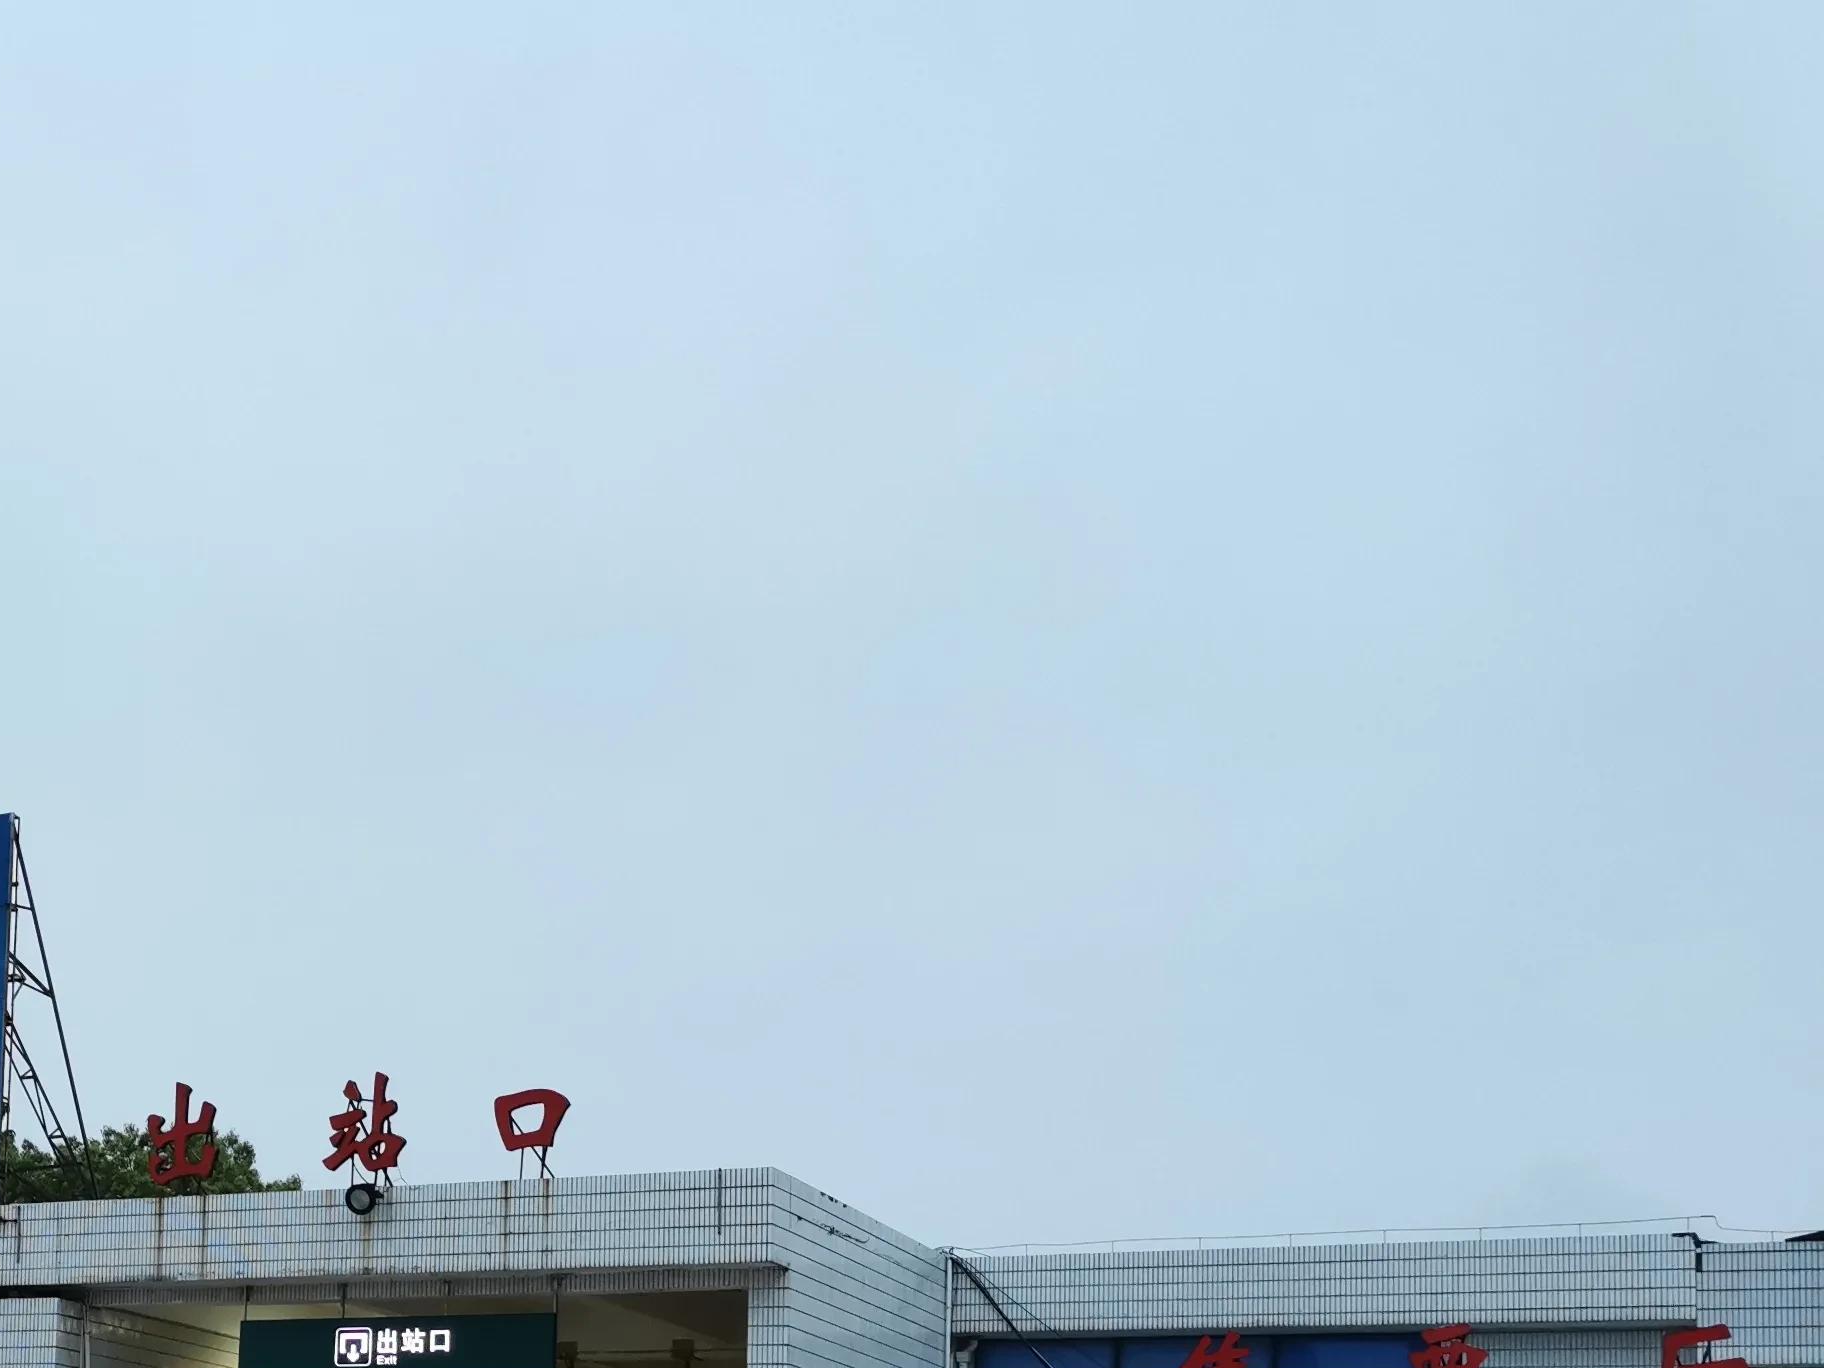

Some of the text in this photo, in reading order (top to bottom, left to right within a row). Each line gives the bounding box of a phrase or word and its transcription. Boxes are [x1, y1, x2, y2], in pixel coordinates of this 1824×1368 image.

[147, 1072, 571, 1187] 出站口
[376, 1328, 451, 1354] 出站口
[376, 1355, 397, 1365] Exit
